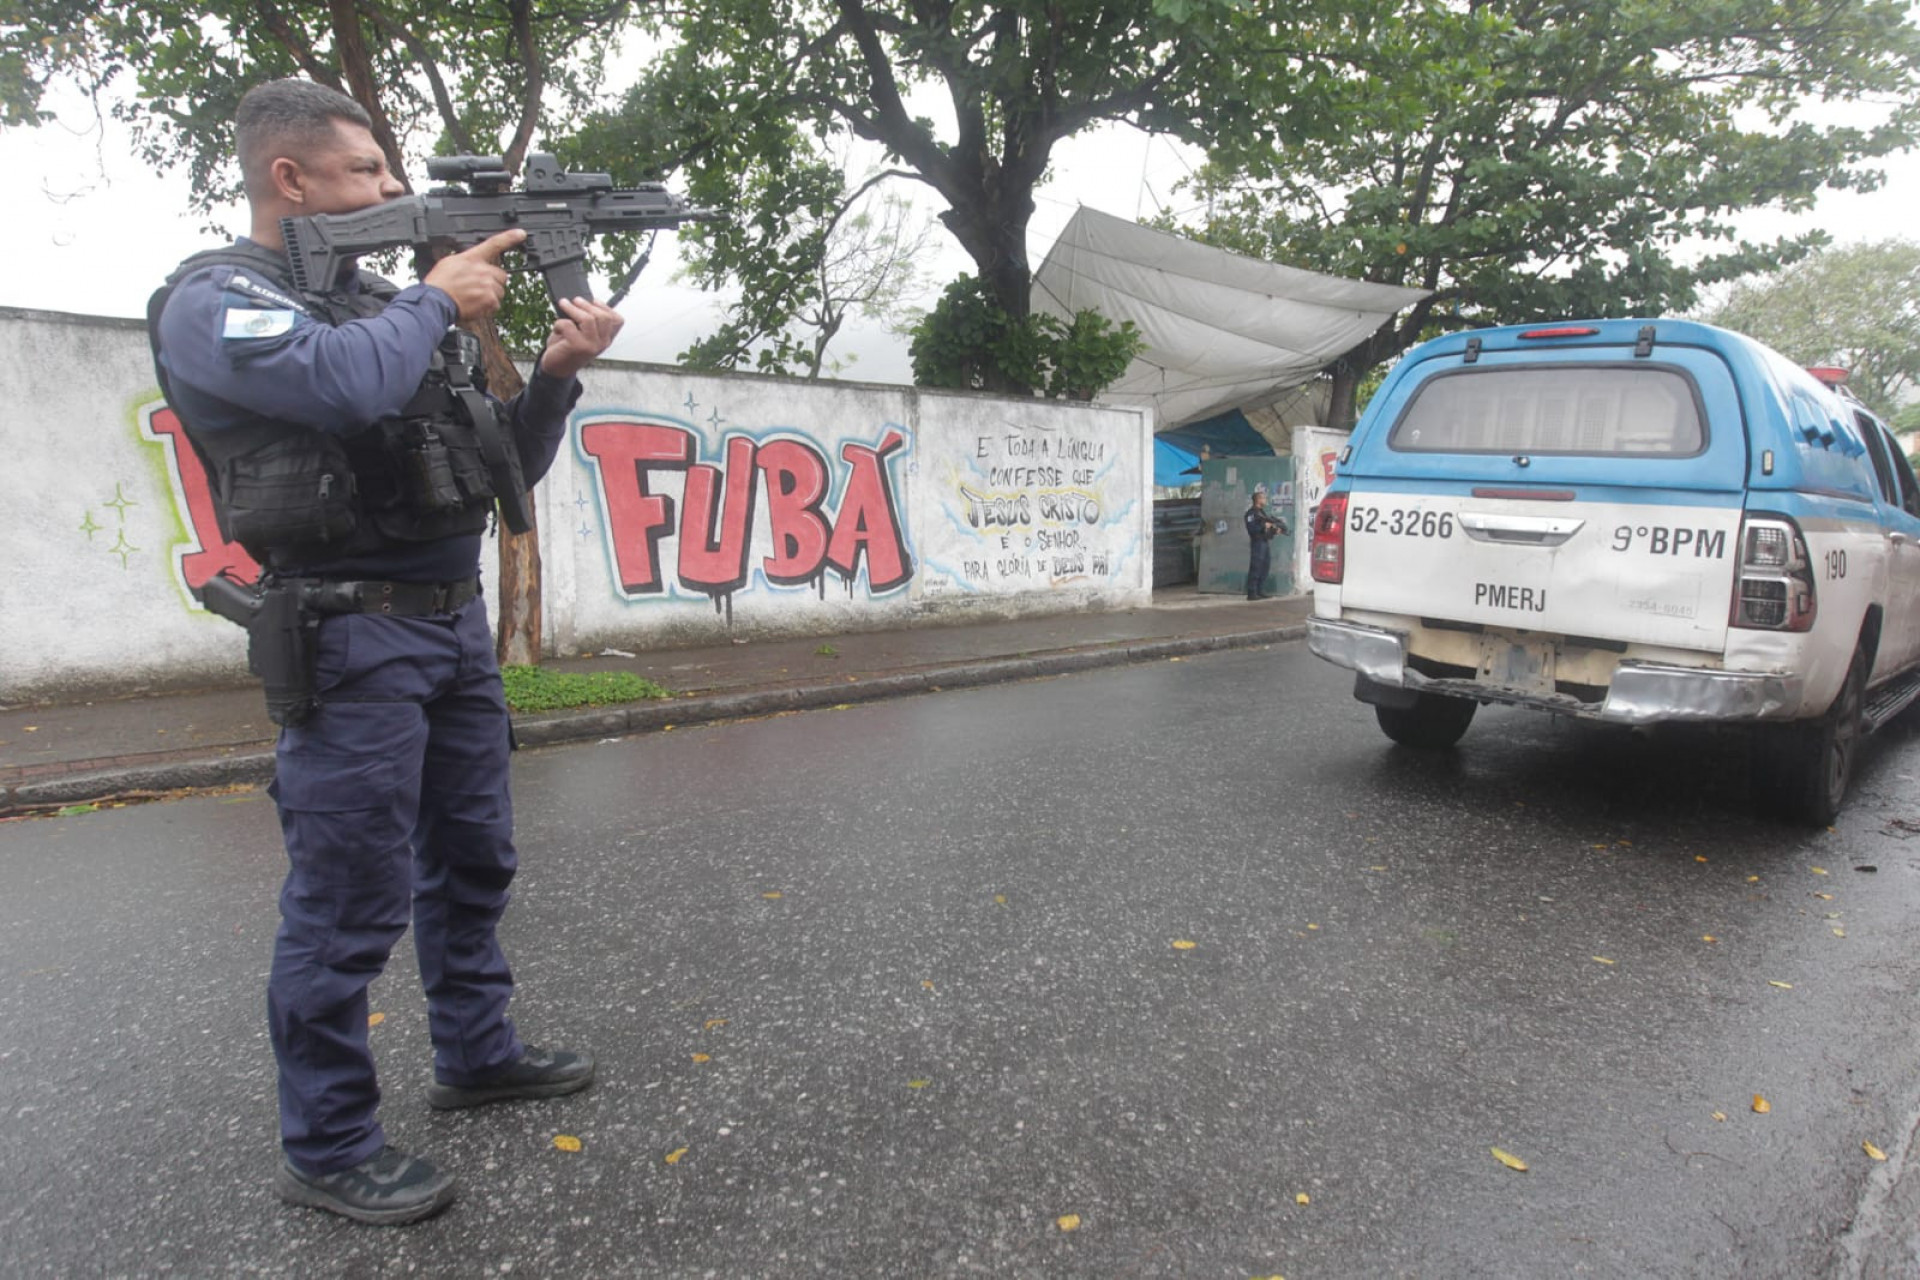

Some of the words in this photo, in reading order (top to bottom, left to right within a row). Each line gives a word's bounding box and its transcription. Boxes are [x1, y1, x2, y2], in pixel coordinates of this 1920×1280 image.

[977, 436, 992, 458] E
[1042, 438, 1050, 458] A
[1057, 437, 1105, 462] LÍNGUA
[989, 466, 1064, 488] CONFESSE
[1072, 469, 1095, 485] QUE
[581, 421, 914, 593] FUBÁ
[960, 486, 1032, 528] JESUS
[1039, 492, 1100, 525] CRISTO
[1350, 506, 1454, 539] 52-3266
[1001, 530, 1010, 550] É
[963, 560, 990, 581] PARA
[996, 553, 1032, 580] GLÓRIA
[1052, 552, 1085, 577] DEUS
[1825, 548, 1847, 580] 190
[1475, 582, 1547, 613] PMERJ
